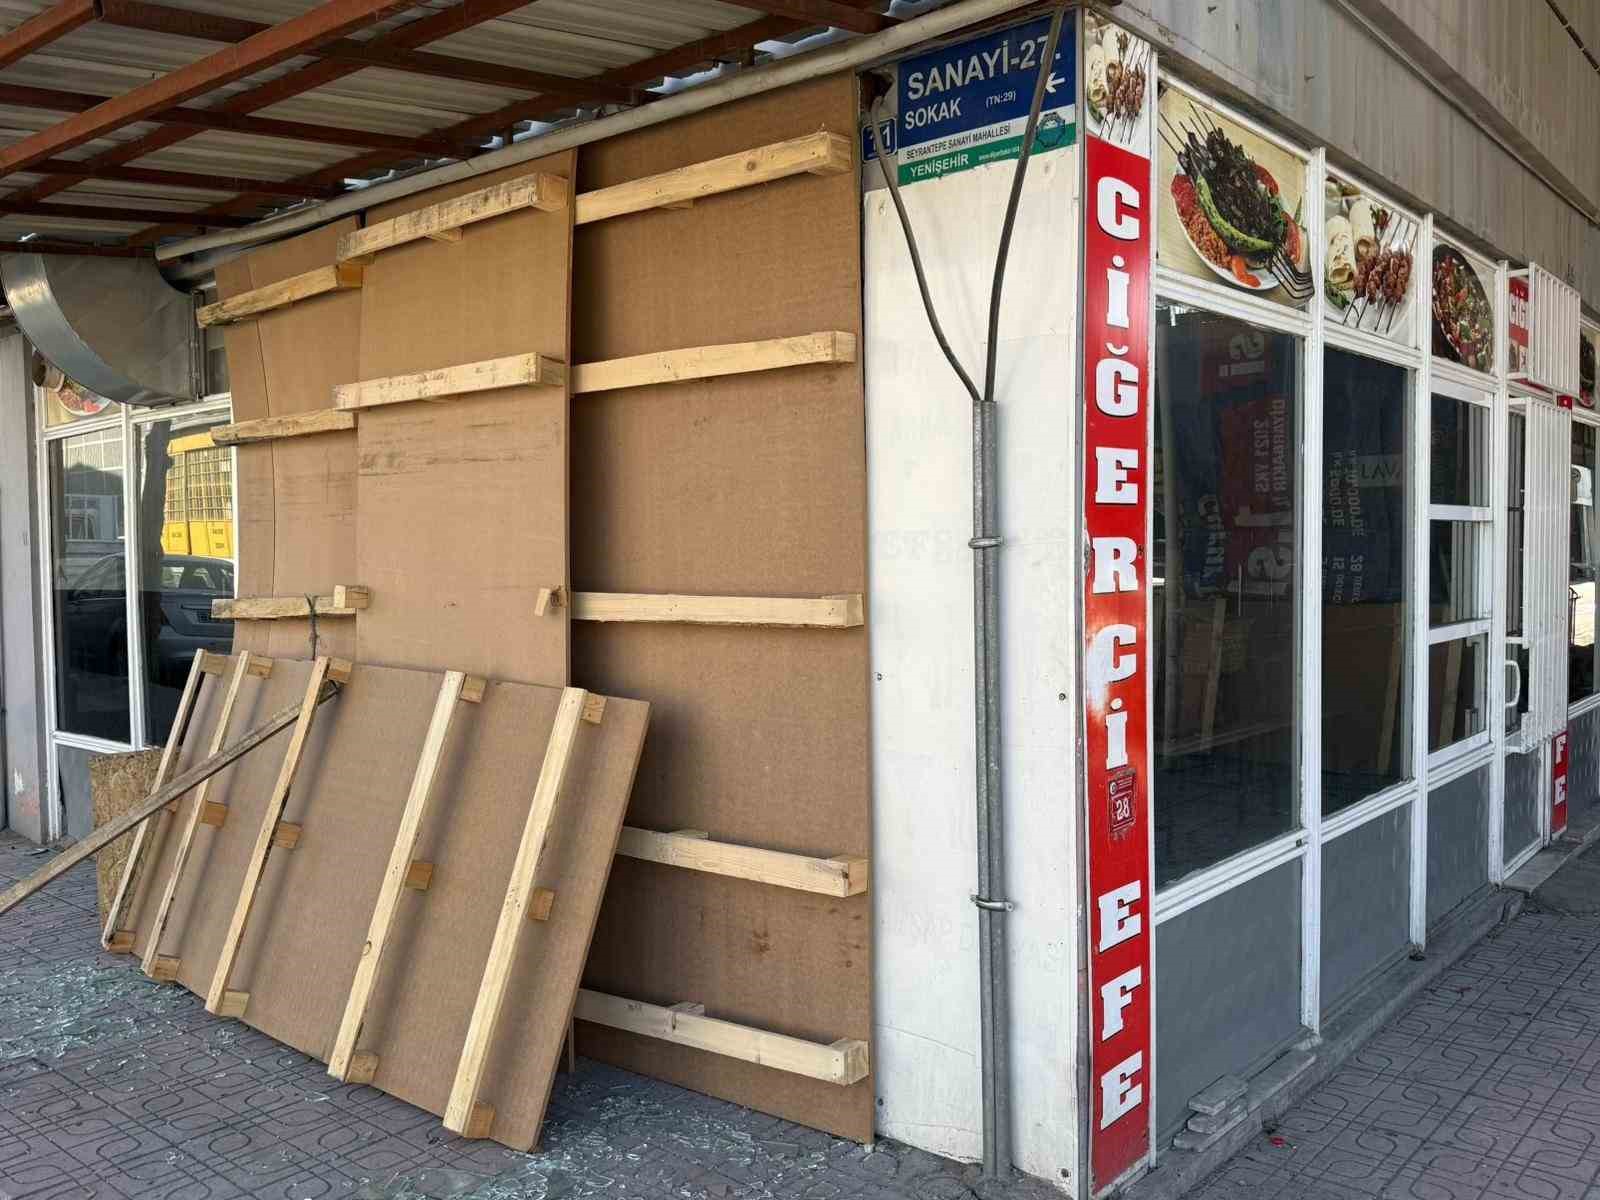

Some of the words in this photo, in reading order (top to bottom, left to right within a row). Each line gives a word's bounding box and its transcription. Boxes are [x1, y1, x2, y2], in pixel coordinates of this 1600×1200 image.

[904, 97, 961, 130] SOKAK
[906, 142, 949, 160] SEYRANTEPE
[949, 133, 971, 150] SANAYİ
[972, 123, 1011, 143] MAHALLESİ
[910, 153, 969, 178] YENİŞEHİR
[1088, 176, 1141, 772] CİĞERCİ
[1116, 796, 1130, 821] 28
[1097, 879, 1143, 1130] EFE
